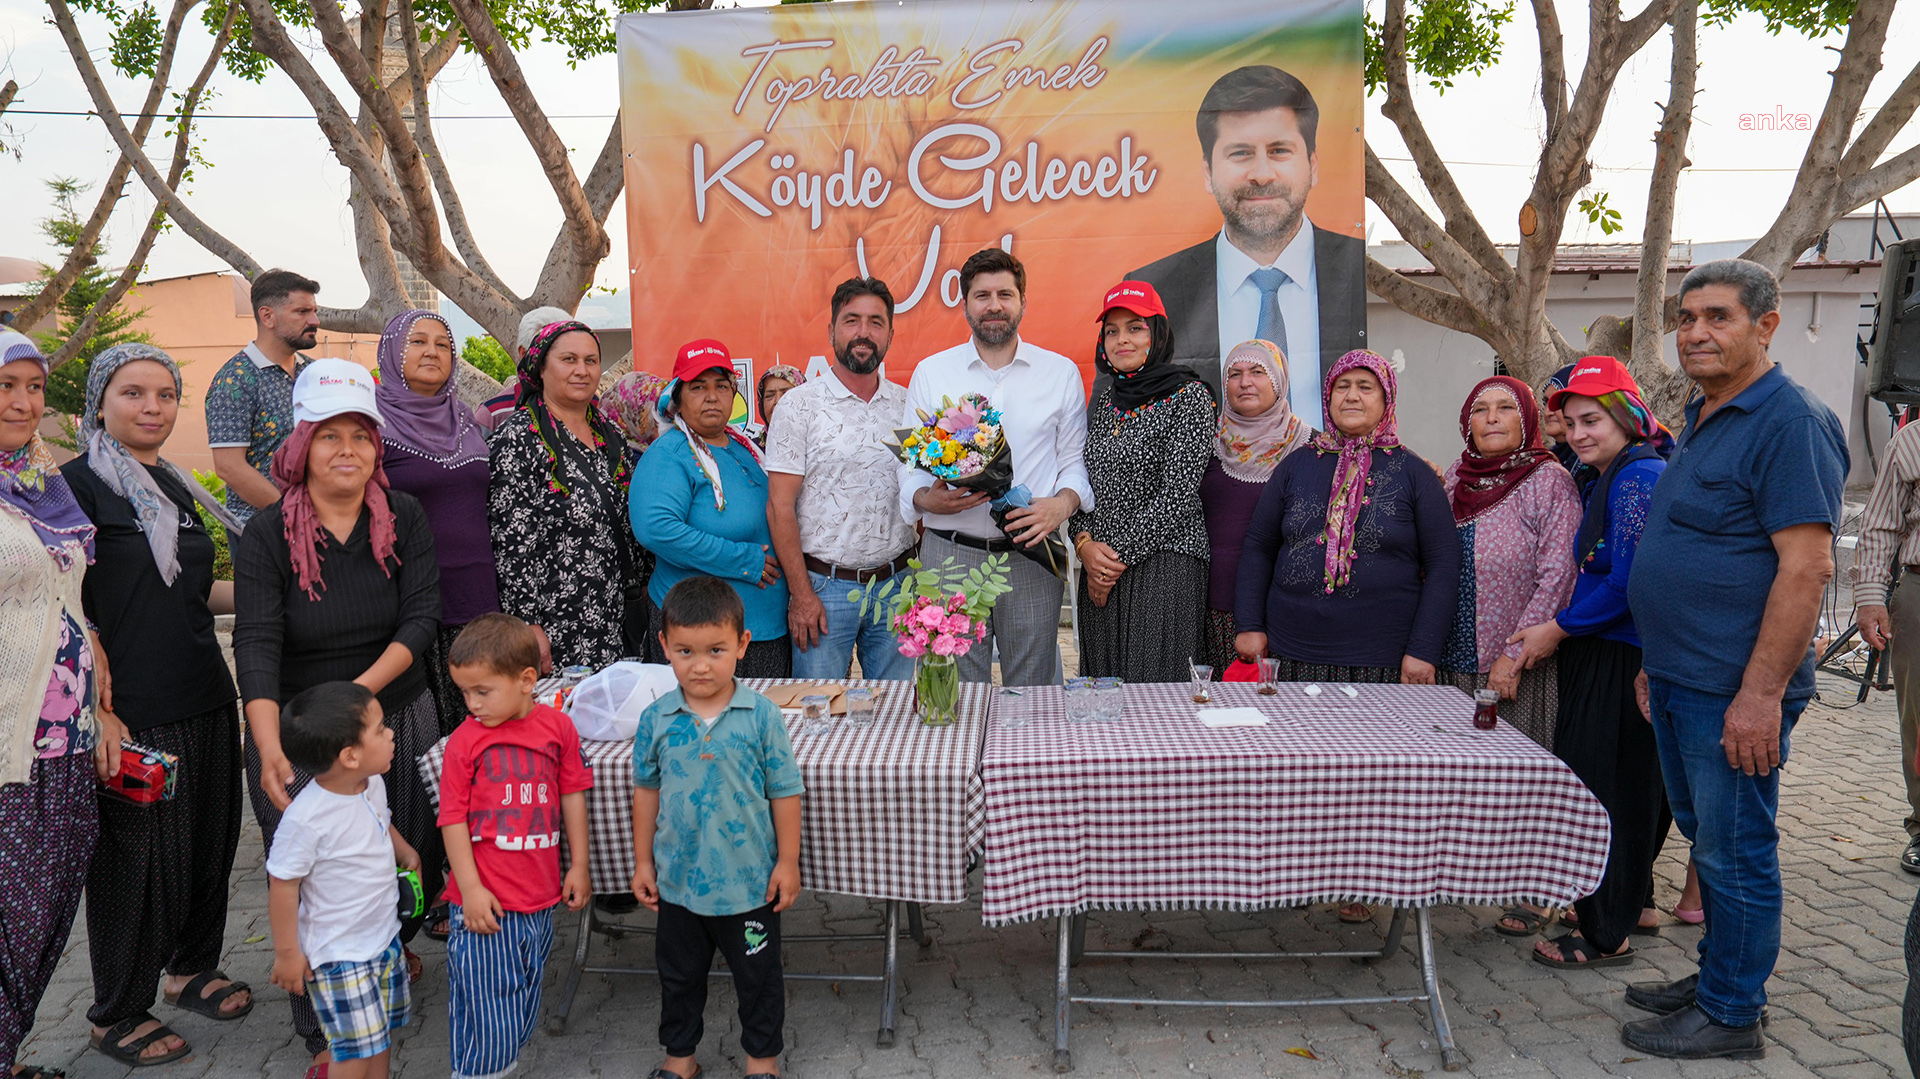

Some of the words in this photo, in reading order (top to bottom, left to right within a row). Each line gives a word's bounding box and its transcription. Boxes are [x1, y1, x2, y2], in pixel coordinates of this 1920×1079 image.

[735, 40, 940, 132] Toprakta
[951, 37, 1107, 110] Emek
[693, 139, 892, 230] Köyde
[908, 123, 1157, 214] Gelecek
[501, 783, 548, 805] JNR
